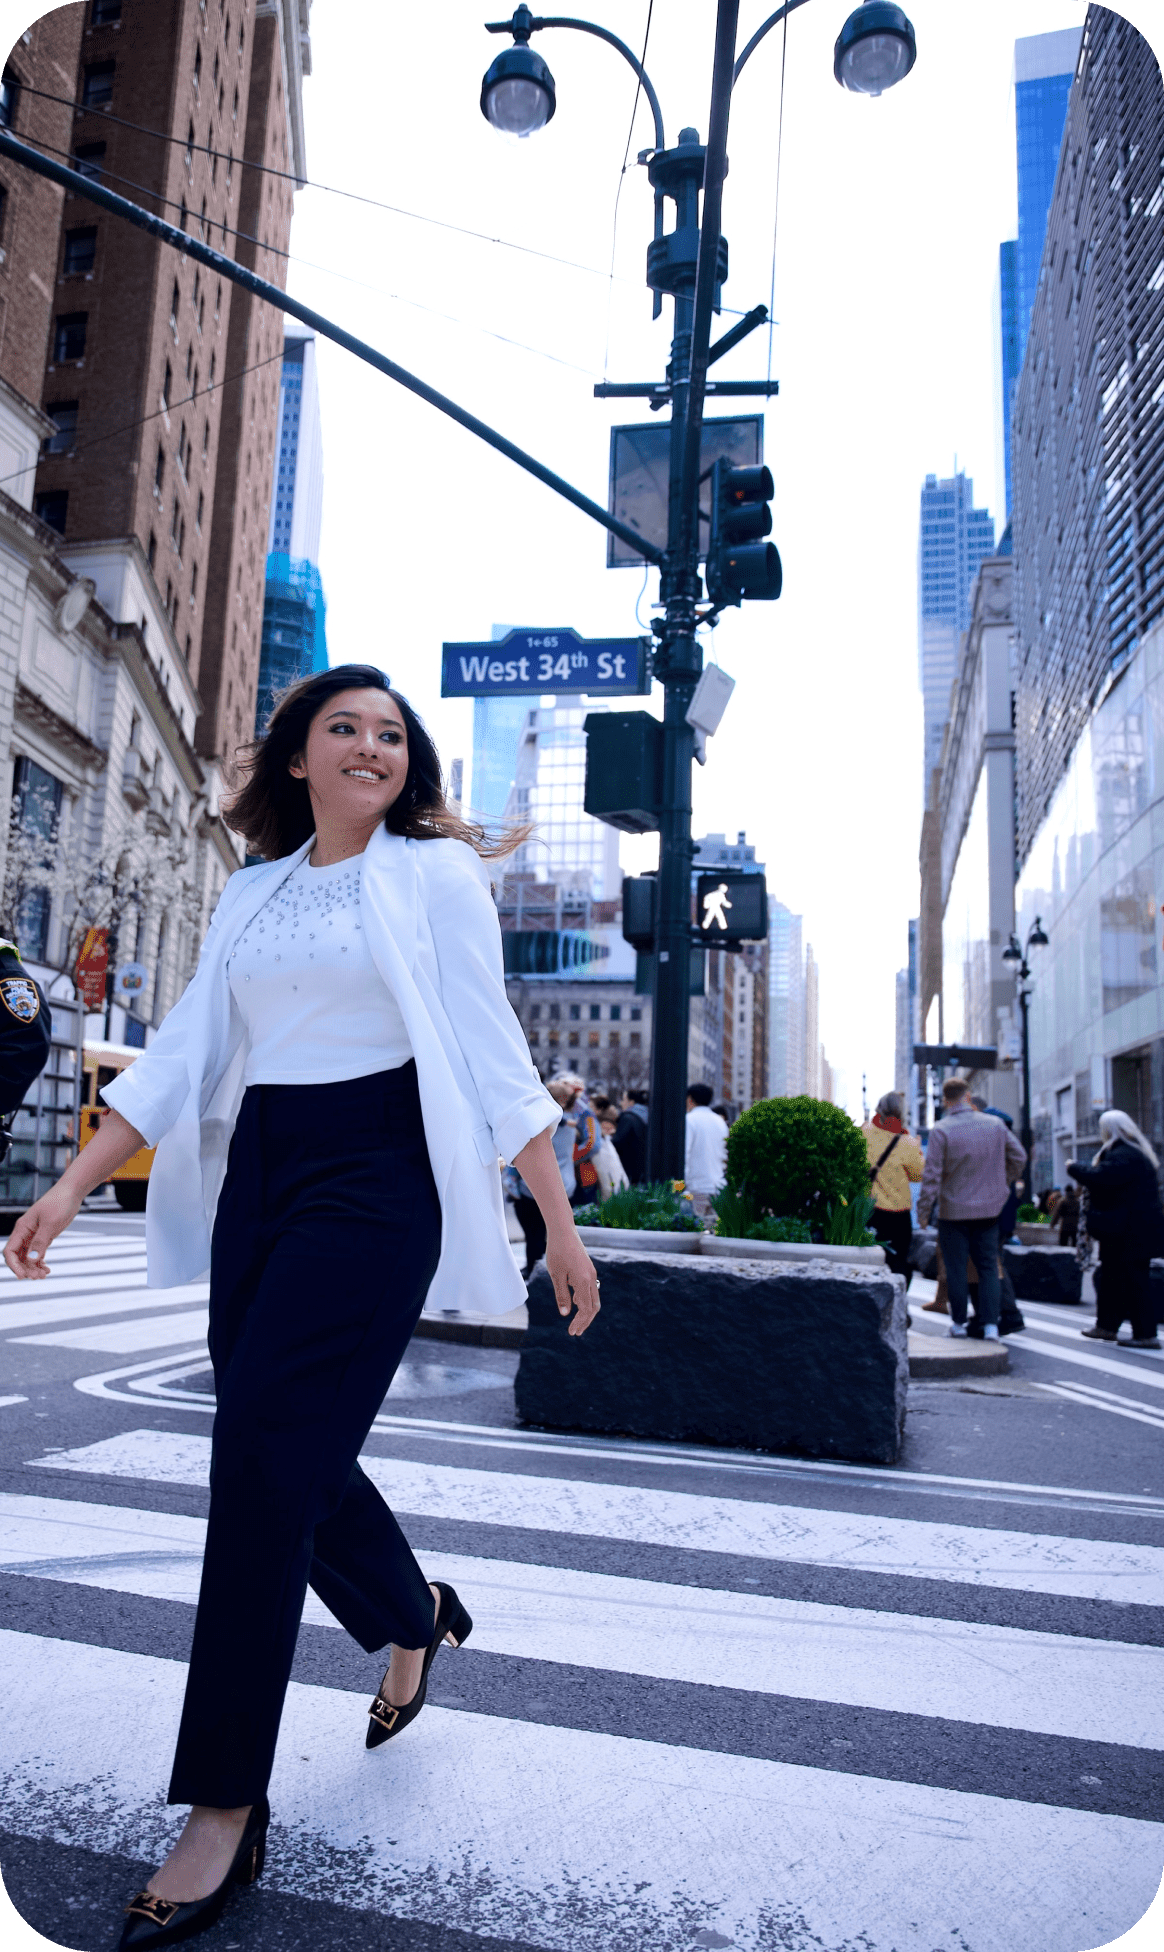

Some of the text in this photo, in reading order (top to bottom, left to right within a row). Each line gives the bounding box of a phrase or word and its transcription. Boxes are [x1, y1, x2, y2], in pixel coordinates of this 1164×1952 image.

[459, 650, 626, 682] West 34th St
